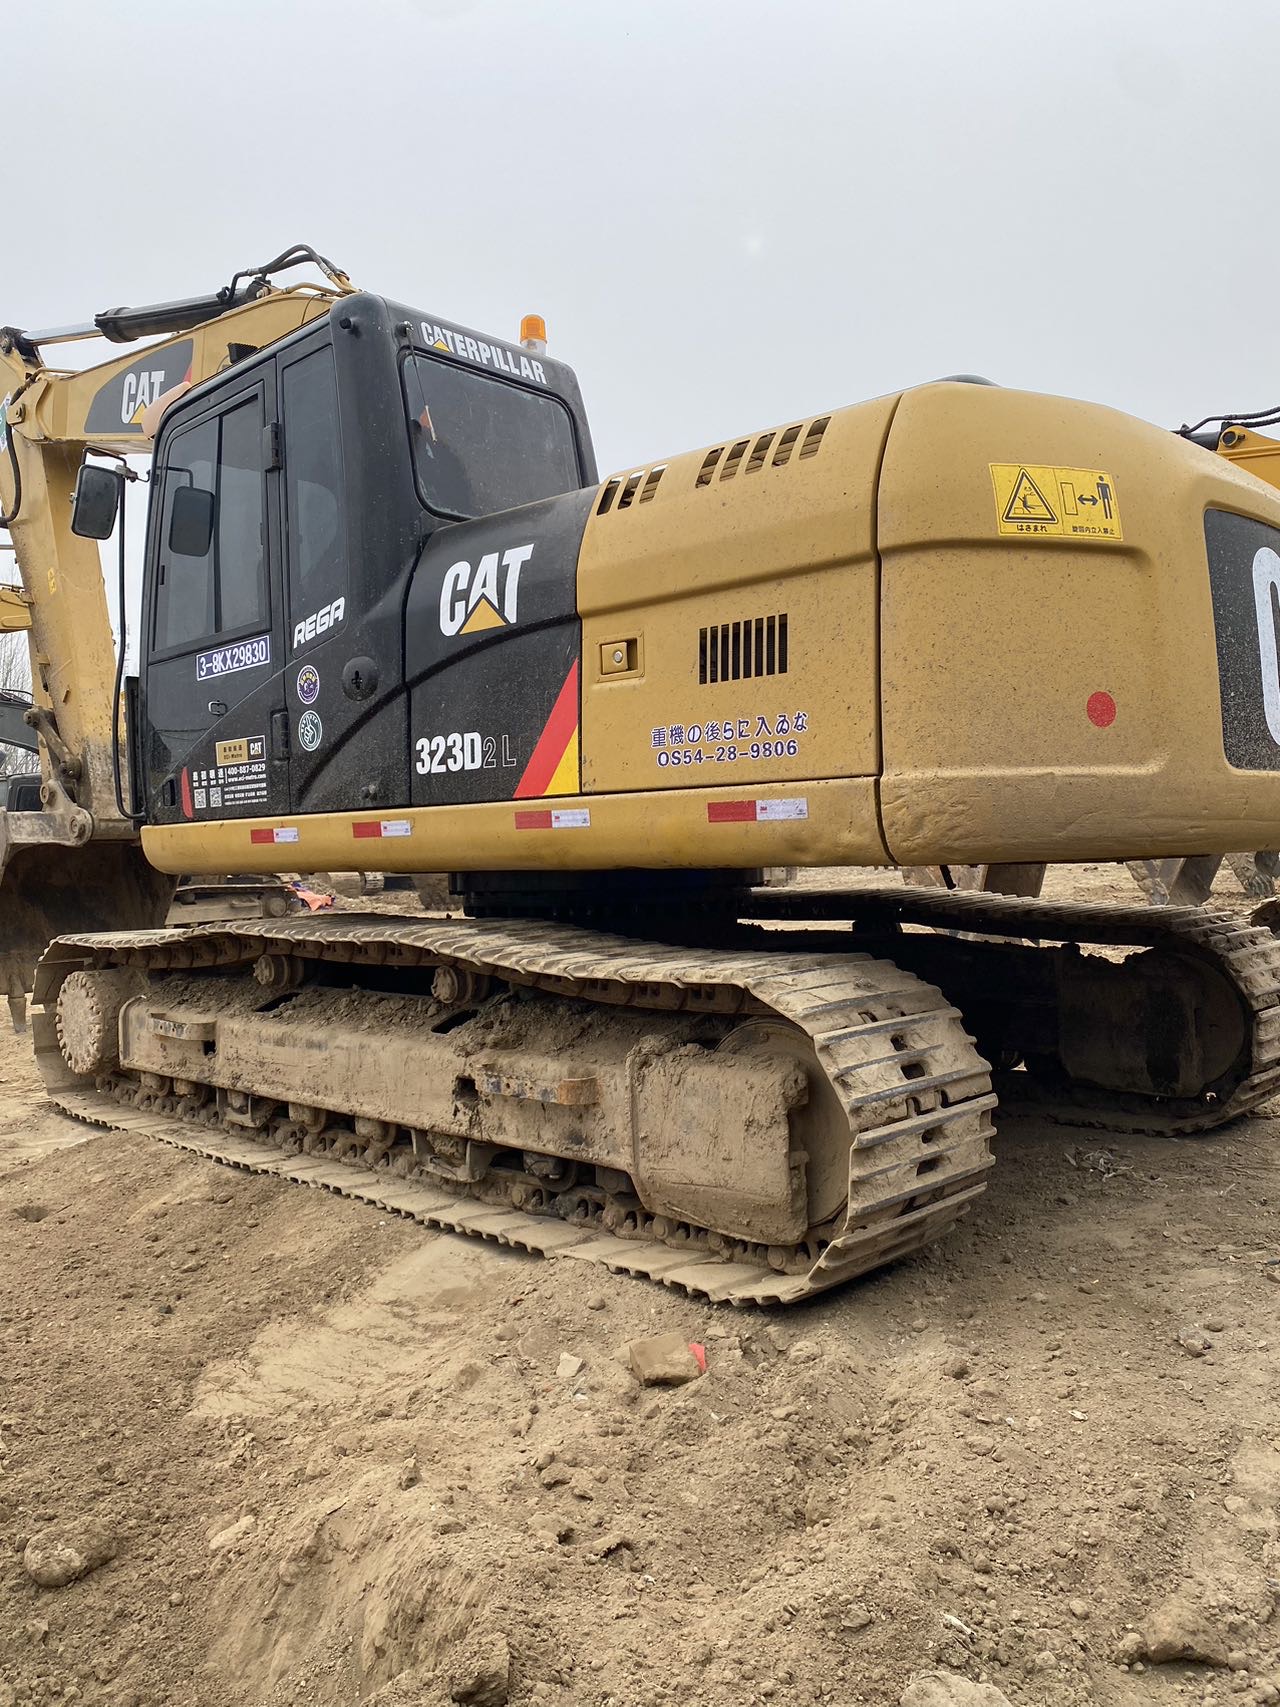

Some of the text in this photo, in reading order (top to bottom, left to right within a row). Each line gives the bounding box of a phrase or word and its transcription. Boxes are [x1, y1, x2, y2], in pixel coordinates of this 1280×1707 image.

[420, 321, 548, 385] CATERPILLAR
[121, 370, 165, 424] CAT
[440, 543, 535, 637] CAT
[293, 597, 345, 649] REGA
[200, 641, 266, 677] 3-8KX29830
[250, 741, 262, 755] CAT
[657, 738, 799, 767] OS54-28-9806
